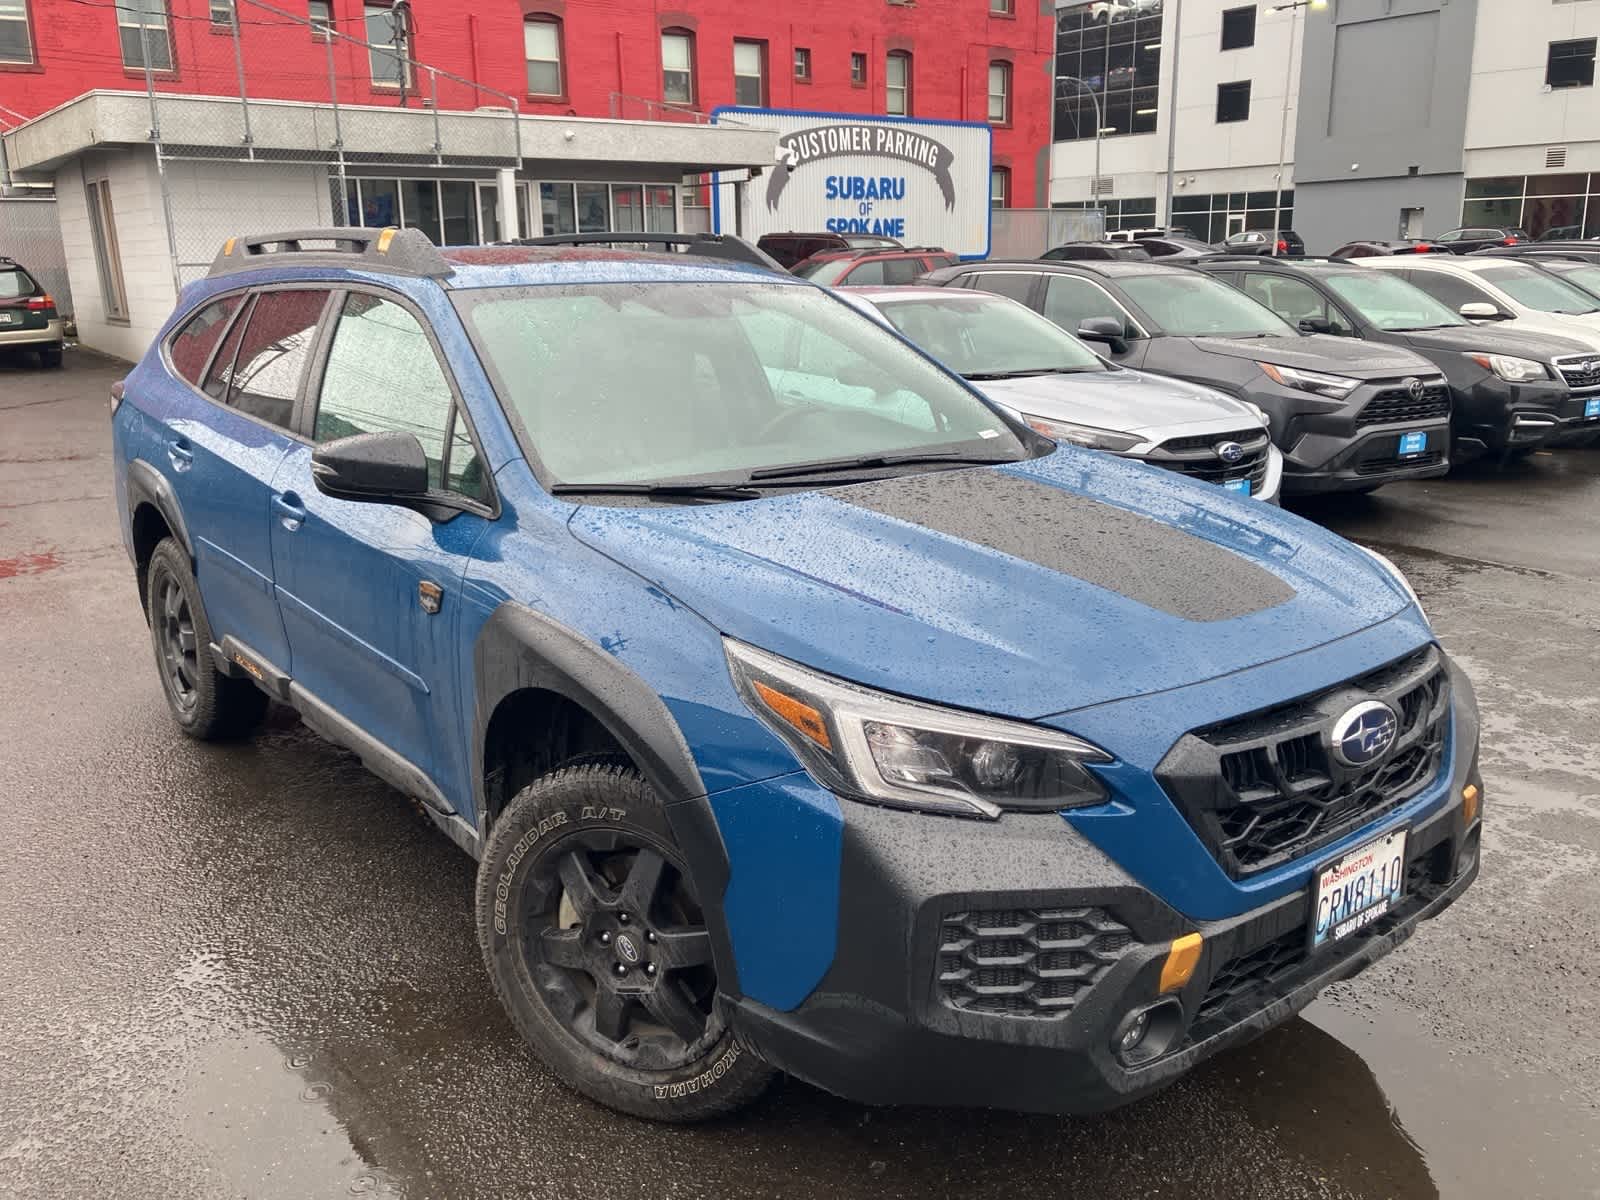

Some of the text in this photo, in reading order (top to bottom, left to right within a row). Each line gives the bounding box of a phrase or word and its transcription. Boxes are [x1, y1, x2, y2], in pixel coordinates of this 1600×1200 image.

[788, 127, 939, 168] CUSTOMER PARKING
[825, 175, 905, 201] SUBARU
[859, 201, 873, 216] OF
[826, 217, 905, 238] SPOKANE
[494, 806, 626, 935] GEOLANDAR A/T
[1321, 855, 1374, 889] WASHINGTON
[1315, 855, 1401, 936] CRN8110
[1335, 917, 1358, 940] SUBARU
[654, 1040, 743, 1099] OKOHAMA
